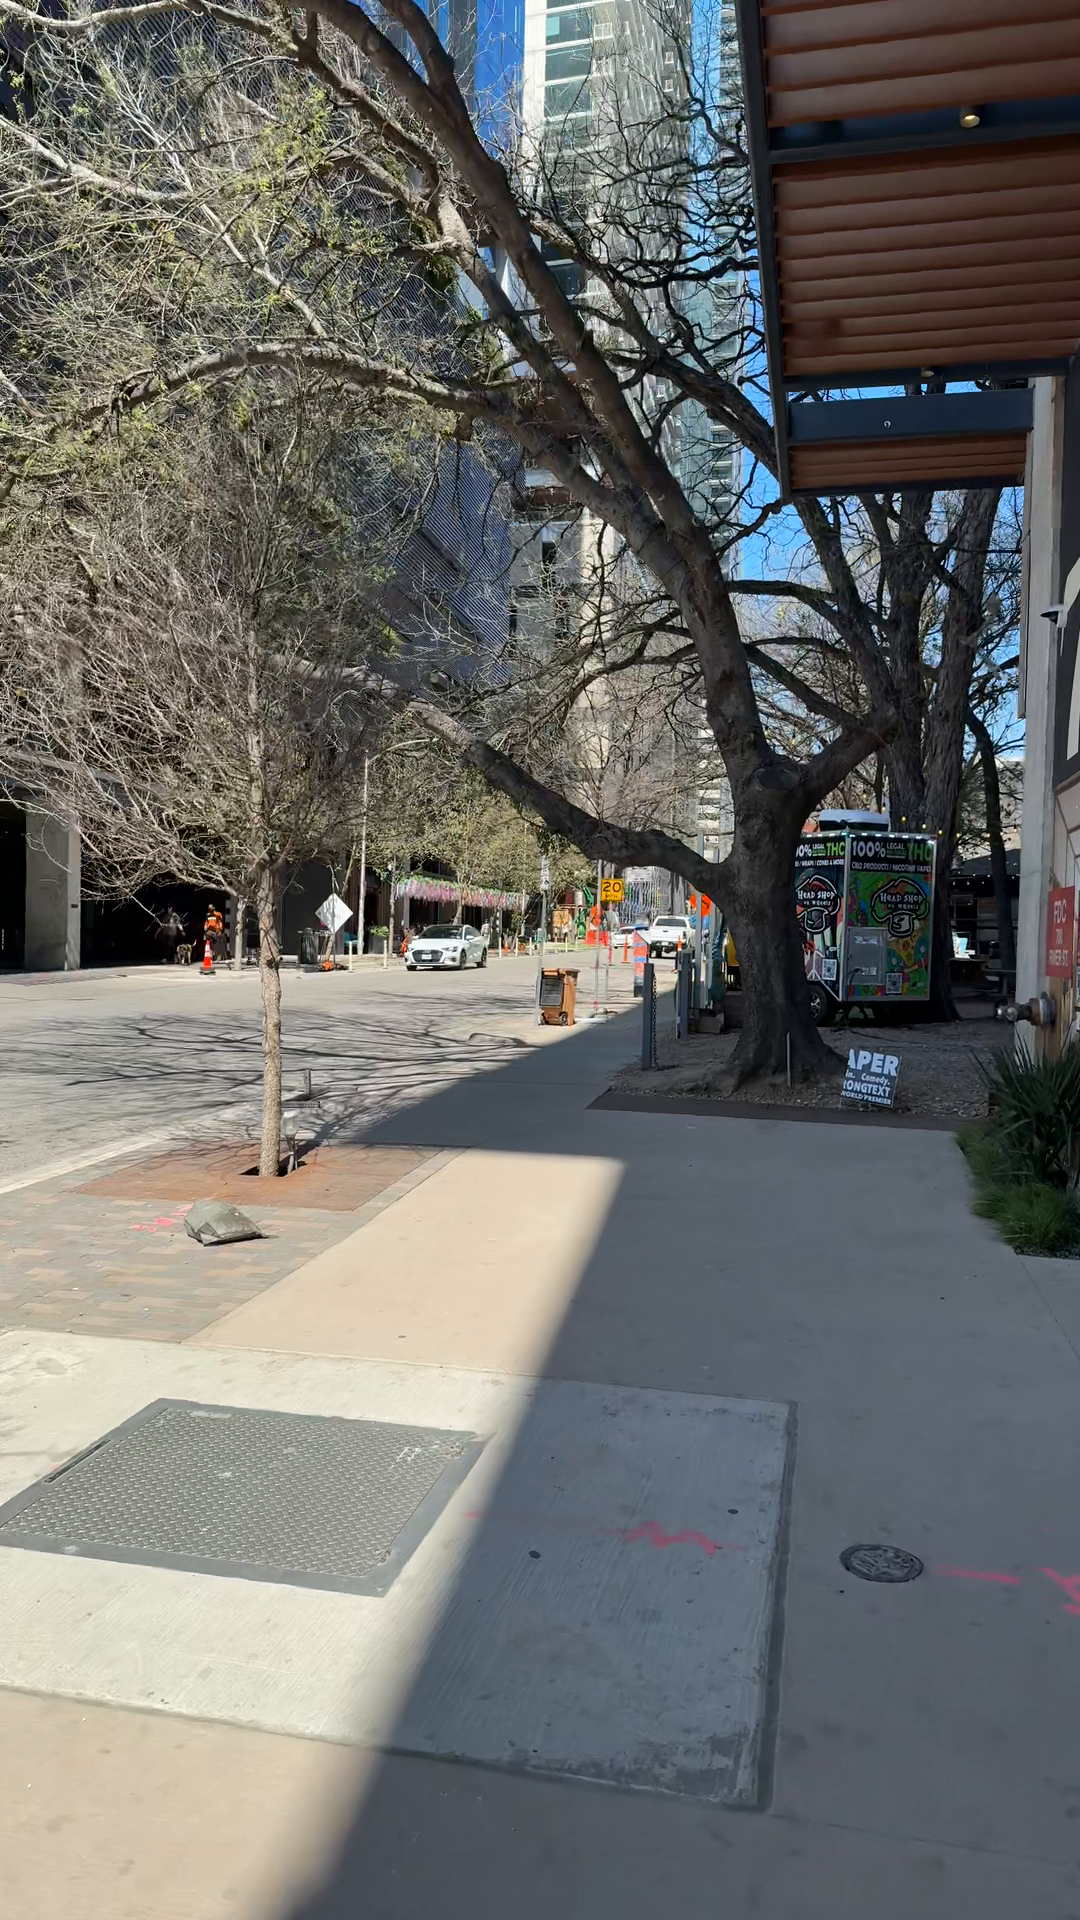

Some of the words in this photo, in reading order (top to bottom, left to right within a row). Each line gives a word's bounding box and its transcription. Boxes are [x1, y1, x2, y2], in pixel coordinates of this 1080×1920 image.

[826, 842, 845, 857] THC
[852, 840, 886, 858] 100%
[886, 842, 905, 850] LEGAL
[907, 843, 933, 861] THC
[863, 862, 889, 871] PRODUCTS
[603, 882, 621, 892] 20
[1053, 898, 1067, 924] FDC
[861, 1073, 891, 1086] Comedy.
